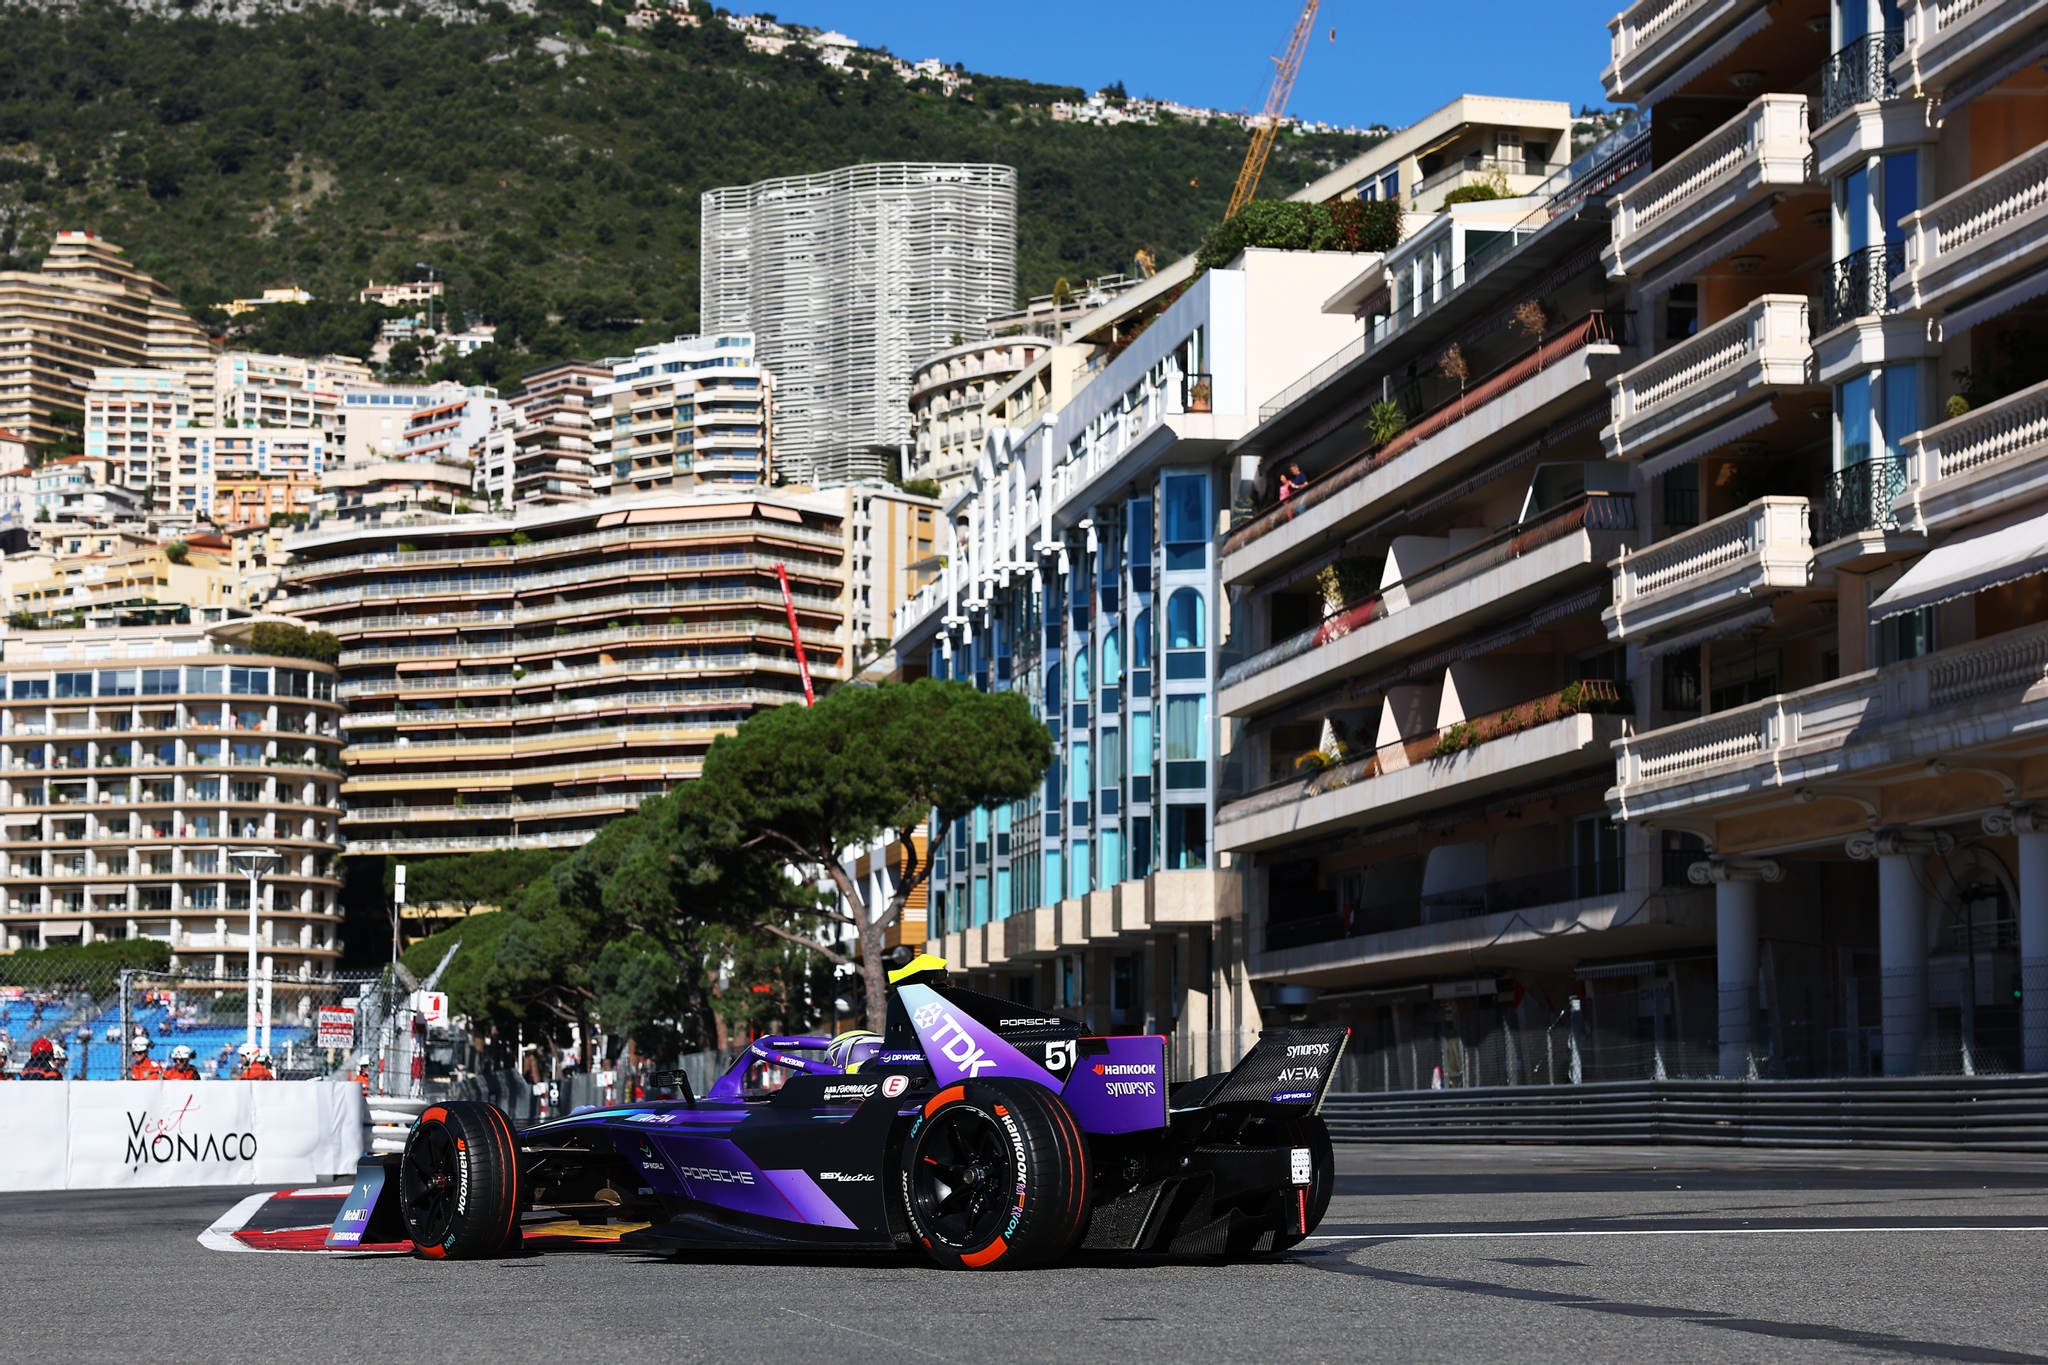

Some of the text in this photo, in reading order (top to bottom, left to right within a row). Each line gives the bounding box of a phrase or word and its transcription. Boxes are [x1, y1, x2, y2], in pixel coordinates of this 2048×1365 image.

[1000, 1018, 1060, 1027] PORSCHE
[930, 1013, 997, 1077] TDK
[1286, 1043, 1330, 1058] SYNOPSYS
[1045, 1040, 1077, 1071] 51
[1277, 1066, 1319, 1081] AVEVA
[888, 1078, 902, 1092] E
[1105, 1081, 1157, 1098] SYNOPSYS
[126, 1094, 201, 1144] Visit
[124, 1132, 258, 1164] MONACO
[681, 1166, 755, 1185] PORSCHE
